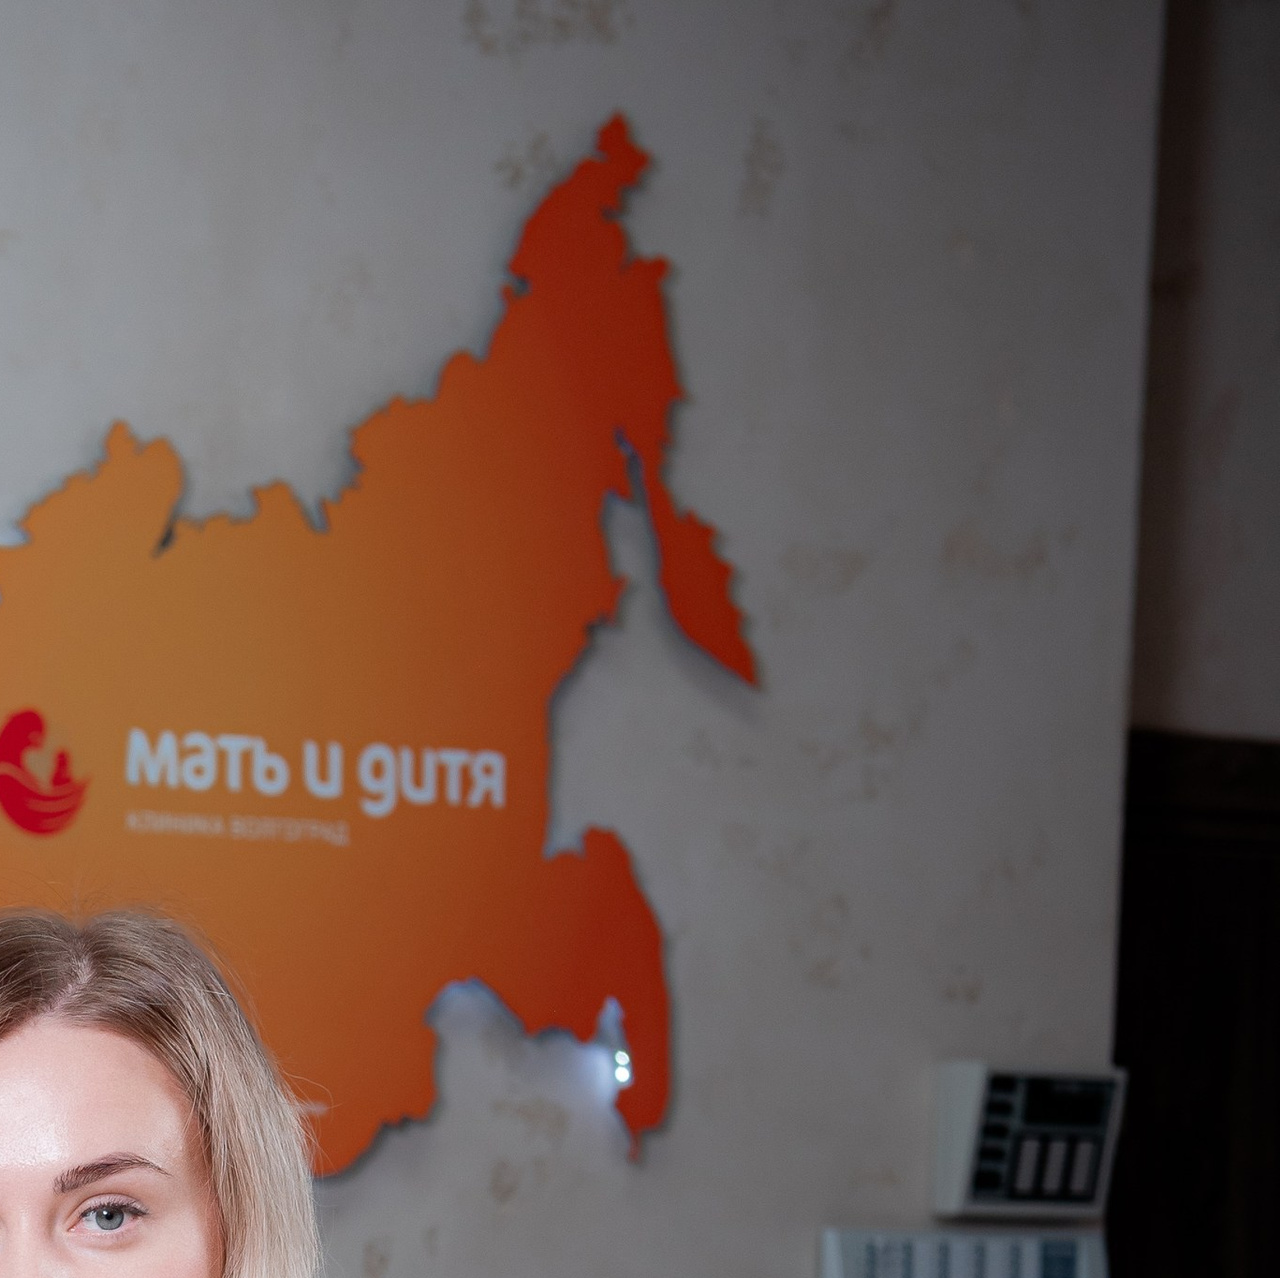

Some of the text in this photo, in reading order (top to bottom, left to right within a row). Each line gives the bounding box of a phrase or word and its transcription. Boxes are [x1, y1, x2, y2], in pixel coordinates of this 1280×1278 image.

[126, 727, 507, 819] мать и дитя
